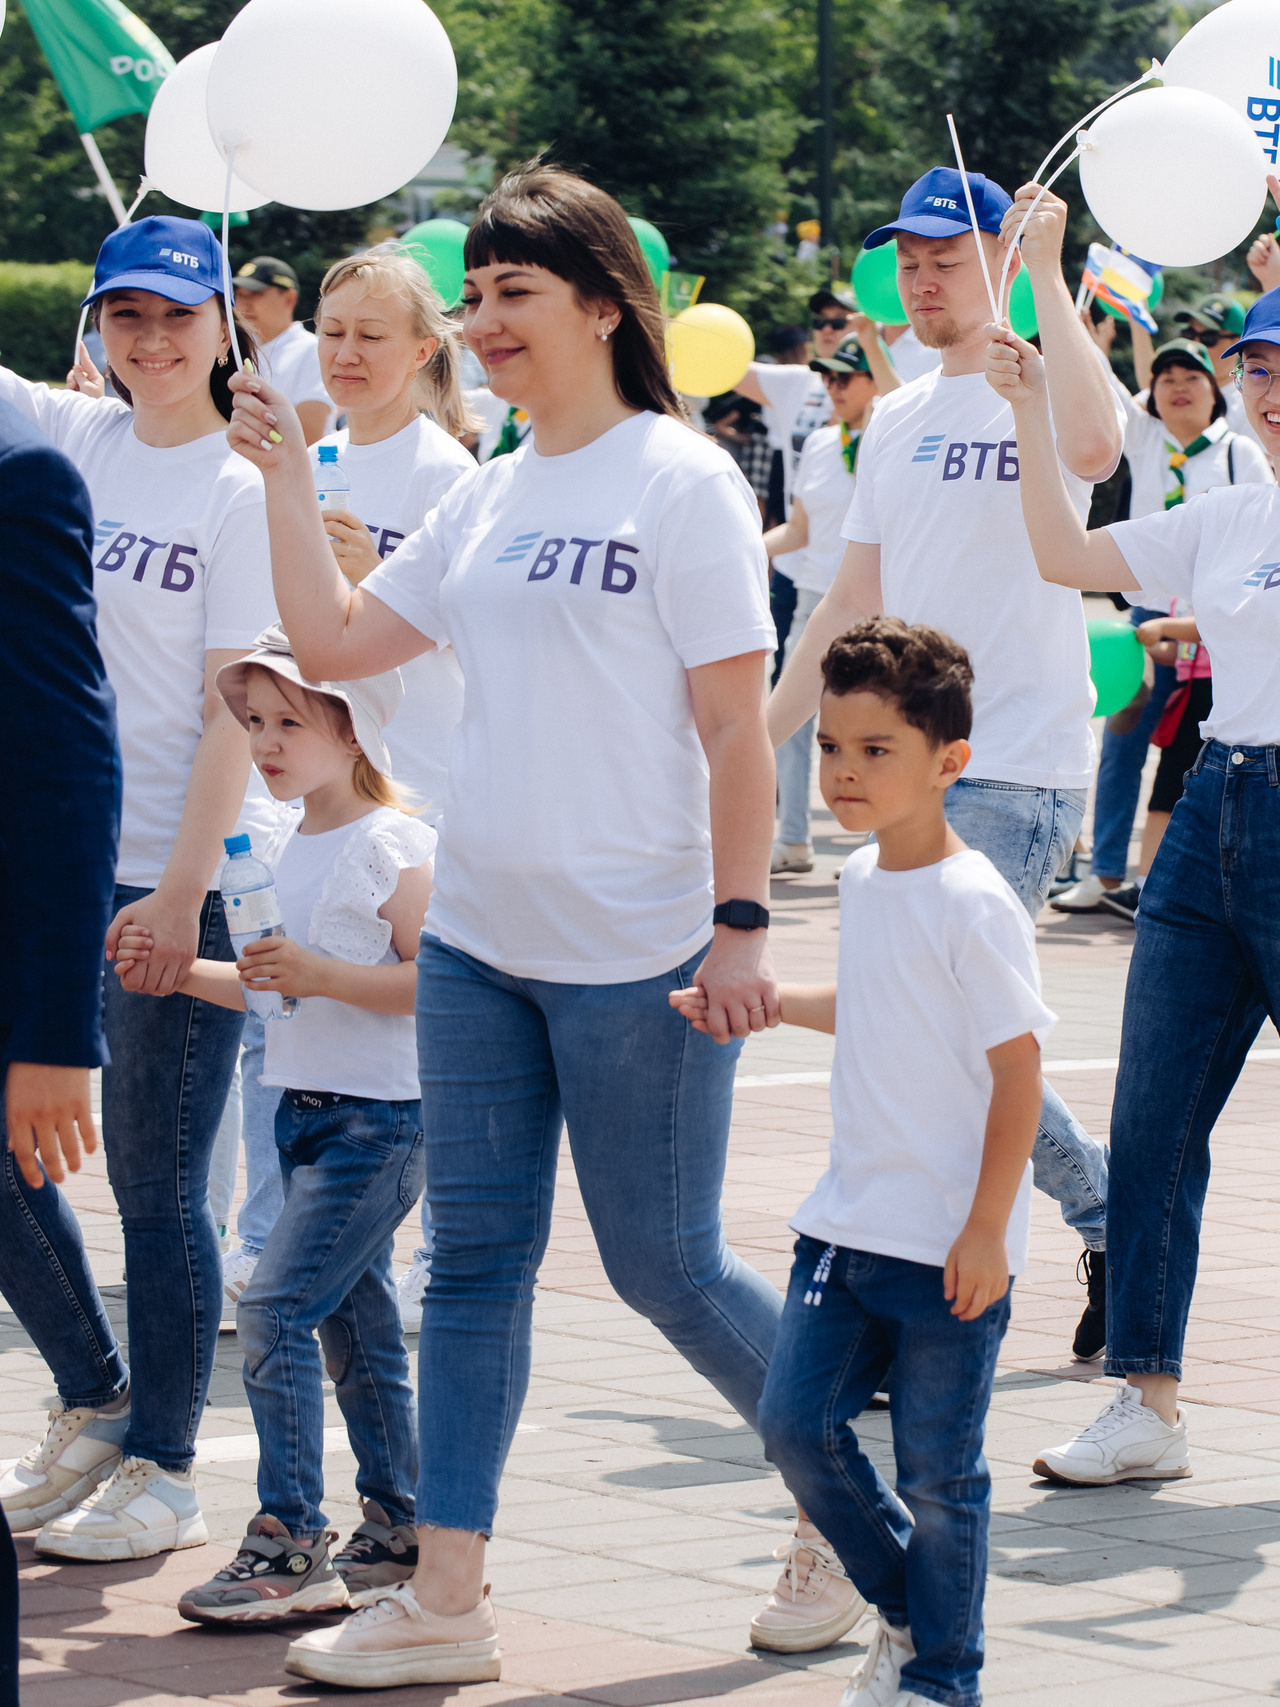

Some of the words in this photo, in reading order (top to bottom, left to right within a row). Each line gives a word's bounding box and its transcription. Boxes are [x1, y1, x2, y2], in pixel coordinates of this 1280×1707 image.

[932, 197, 957, 210] ВТБ
[172, 251, 199, 269] ВТБ
[942, 440, 1020, 482] ВТБ
[95, 531, 198, 593] ВТБ
[527, 537, 640, 594] ВТБ
